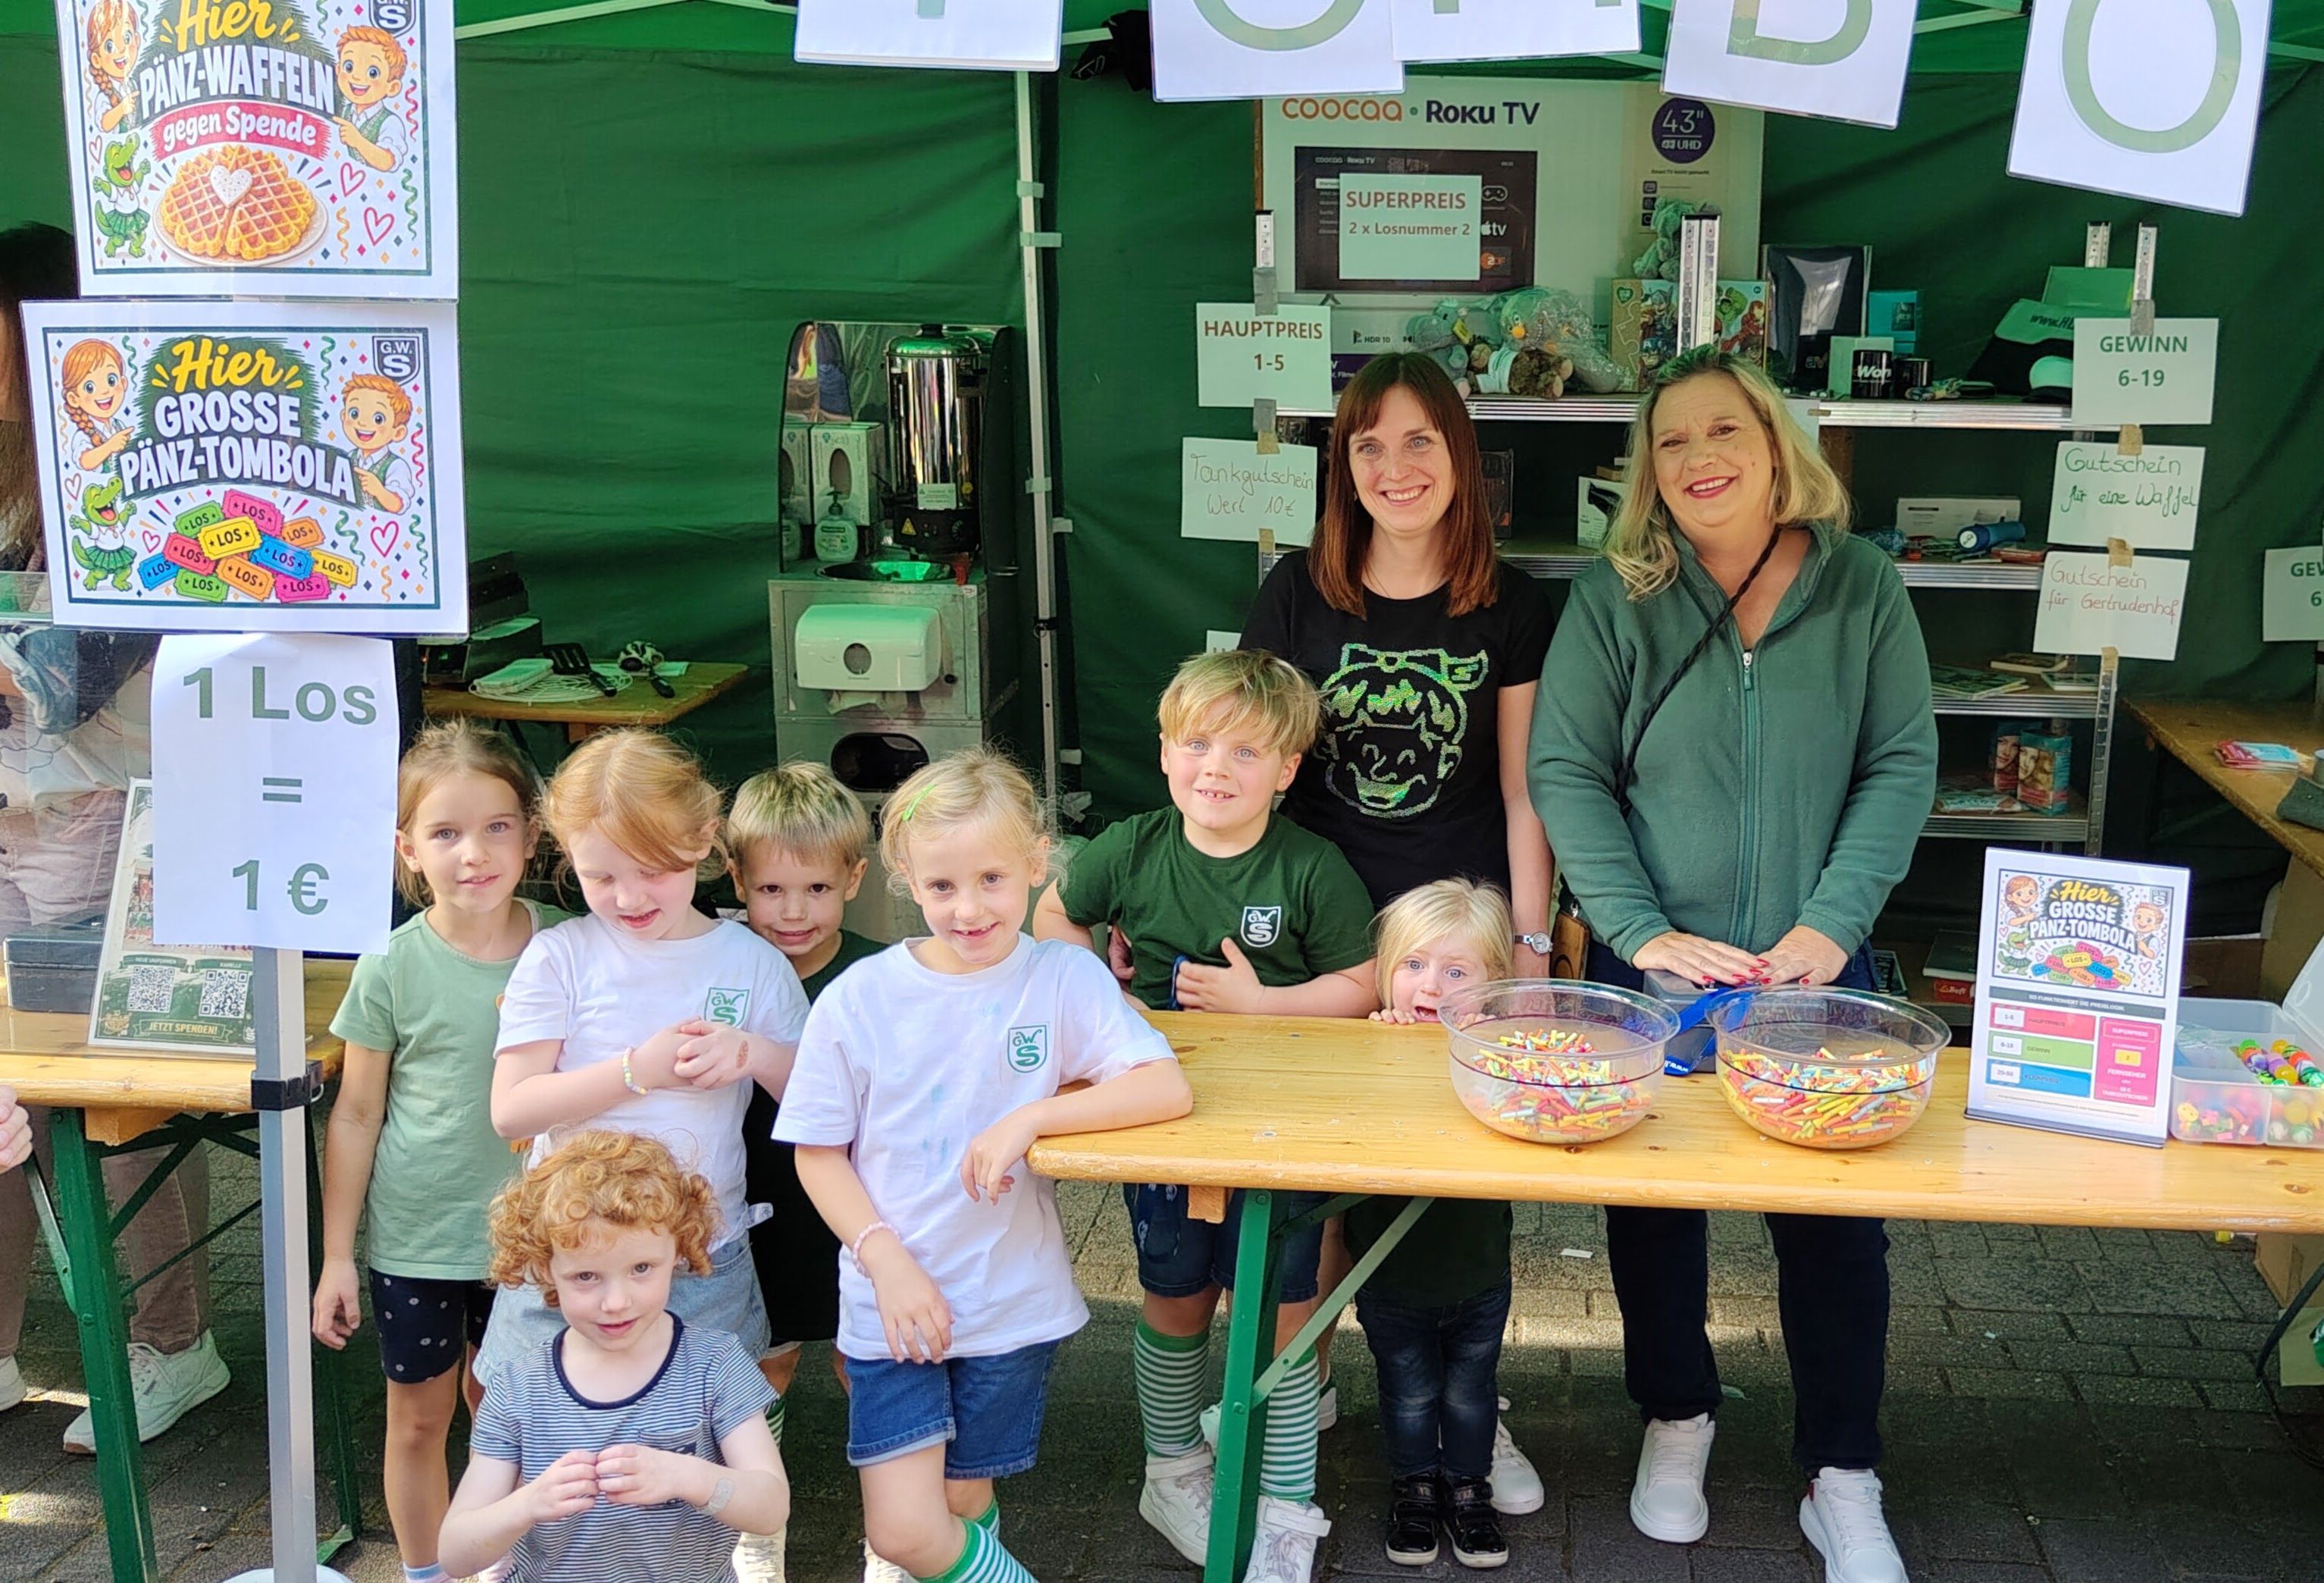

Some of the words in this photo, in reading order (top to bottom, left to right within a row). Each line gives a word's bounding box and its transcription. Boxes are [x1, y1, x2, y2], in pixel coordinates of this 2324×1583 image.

[140, 45, 334, 118] PÄNZ-WAFFELN
[1502, 102, 1540, 125] TV
[162, 112, 221, 152] gegen
[225, 105, 316, 147] Spende
[1677, 139, 1702, 151] UHD
[1345, 191, 1467, 210] SUPERPREIS
[1348, 222, 1357, 235] 2
[1361, 225, 1370, 235] x
[1374, 223, 1458, 237] Losnummer
[1461, 224, 1471, 237] 2
[1204, 320, 1323, 340] HAUPTPREIS
[380, 340, 413, 355] G.W.
[2099, 334, 2188, 353] GEWINN
[172, 338, 278, 392] Hier
[382, 355, 409, 378] S
[1253, 353, 1285, 371] 1-5
[2118, 368, 2166, 388] 6-19
[154, 390, 302, 437] GROSSE
[120, 435, 356, 503] PÄNZ-TOMBOLA
[2064, 447, 2181, 476] Gutschein
[1190, 453, 1314, 496] Tankgutschein
[1207, 494, 1245, 515] Wert
[2060, 484, 2087, 513] für
[2098, 491, 2131, 505] eine
[2135, 482, 2197, 518] Waffel
[189, 513, 210, 528] LOS
[241, 502, 266, 522] LOS
[216, 528, 243, 547] LOS
[286, 526, 309, 541] LOS
[180, 545, 202, 563] LOS
[271, 548, 296, 567] LOS
[152, 560, 171, 576] LOS
[321, 559, 343, 575] LOS
[2050, 559, 2147, 590] Gutschein
[192, 577, 213, 591] LOS
[234, 568, 259, 588] LOS
[290, 579, 313, 593] LOS
[2045, 590, 2069, 611] für
[2081, 593, 2179, 625] Gertrudenhof
[182, 666, 214, 719] 1
[251, 666, 377, 726] Los
[231, 858, 261, 911] 1
[287, 862, 330, 917] €
[2060, 881, 2110, 903] Hier
[2049, 901, 2116, 924] GROSSE
[2029, 916, 2137, 953] PÄNZ-TOMBOLA
[149, 1021, 173, 1032] JETZT
[174, 1023, 218, 1035] SPENDEN!
